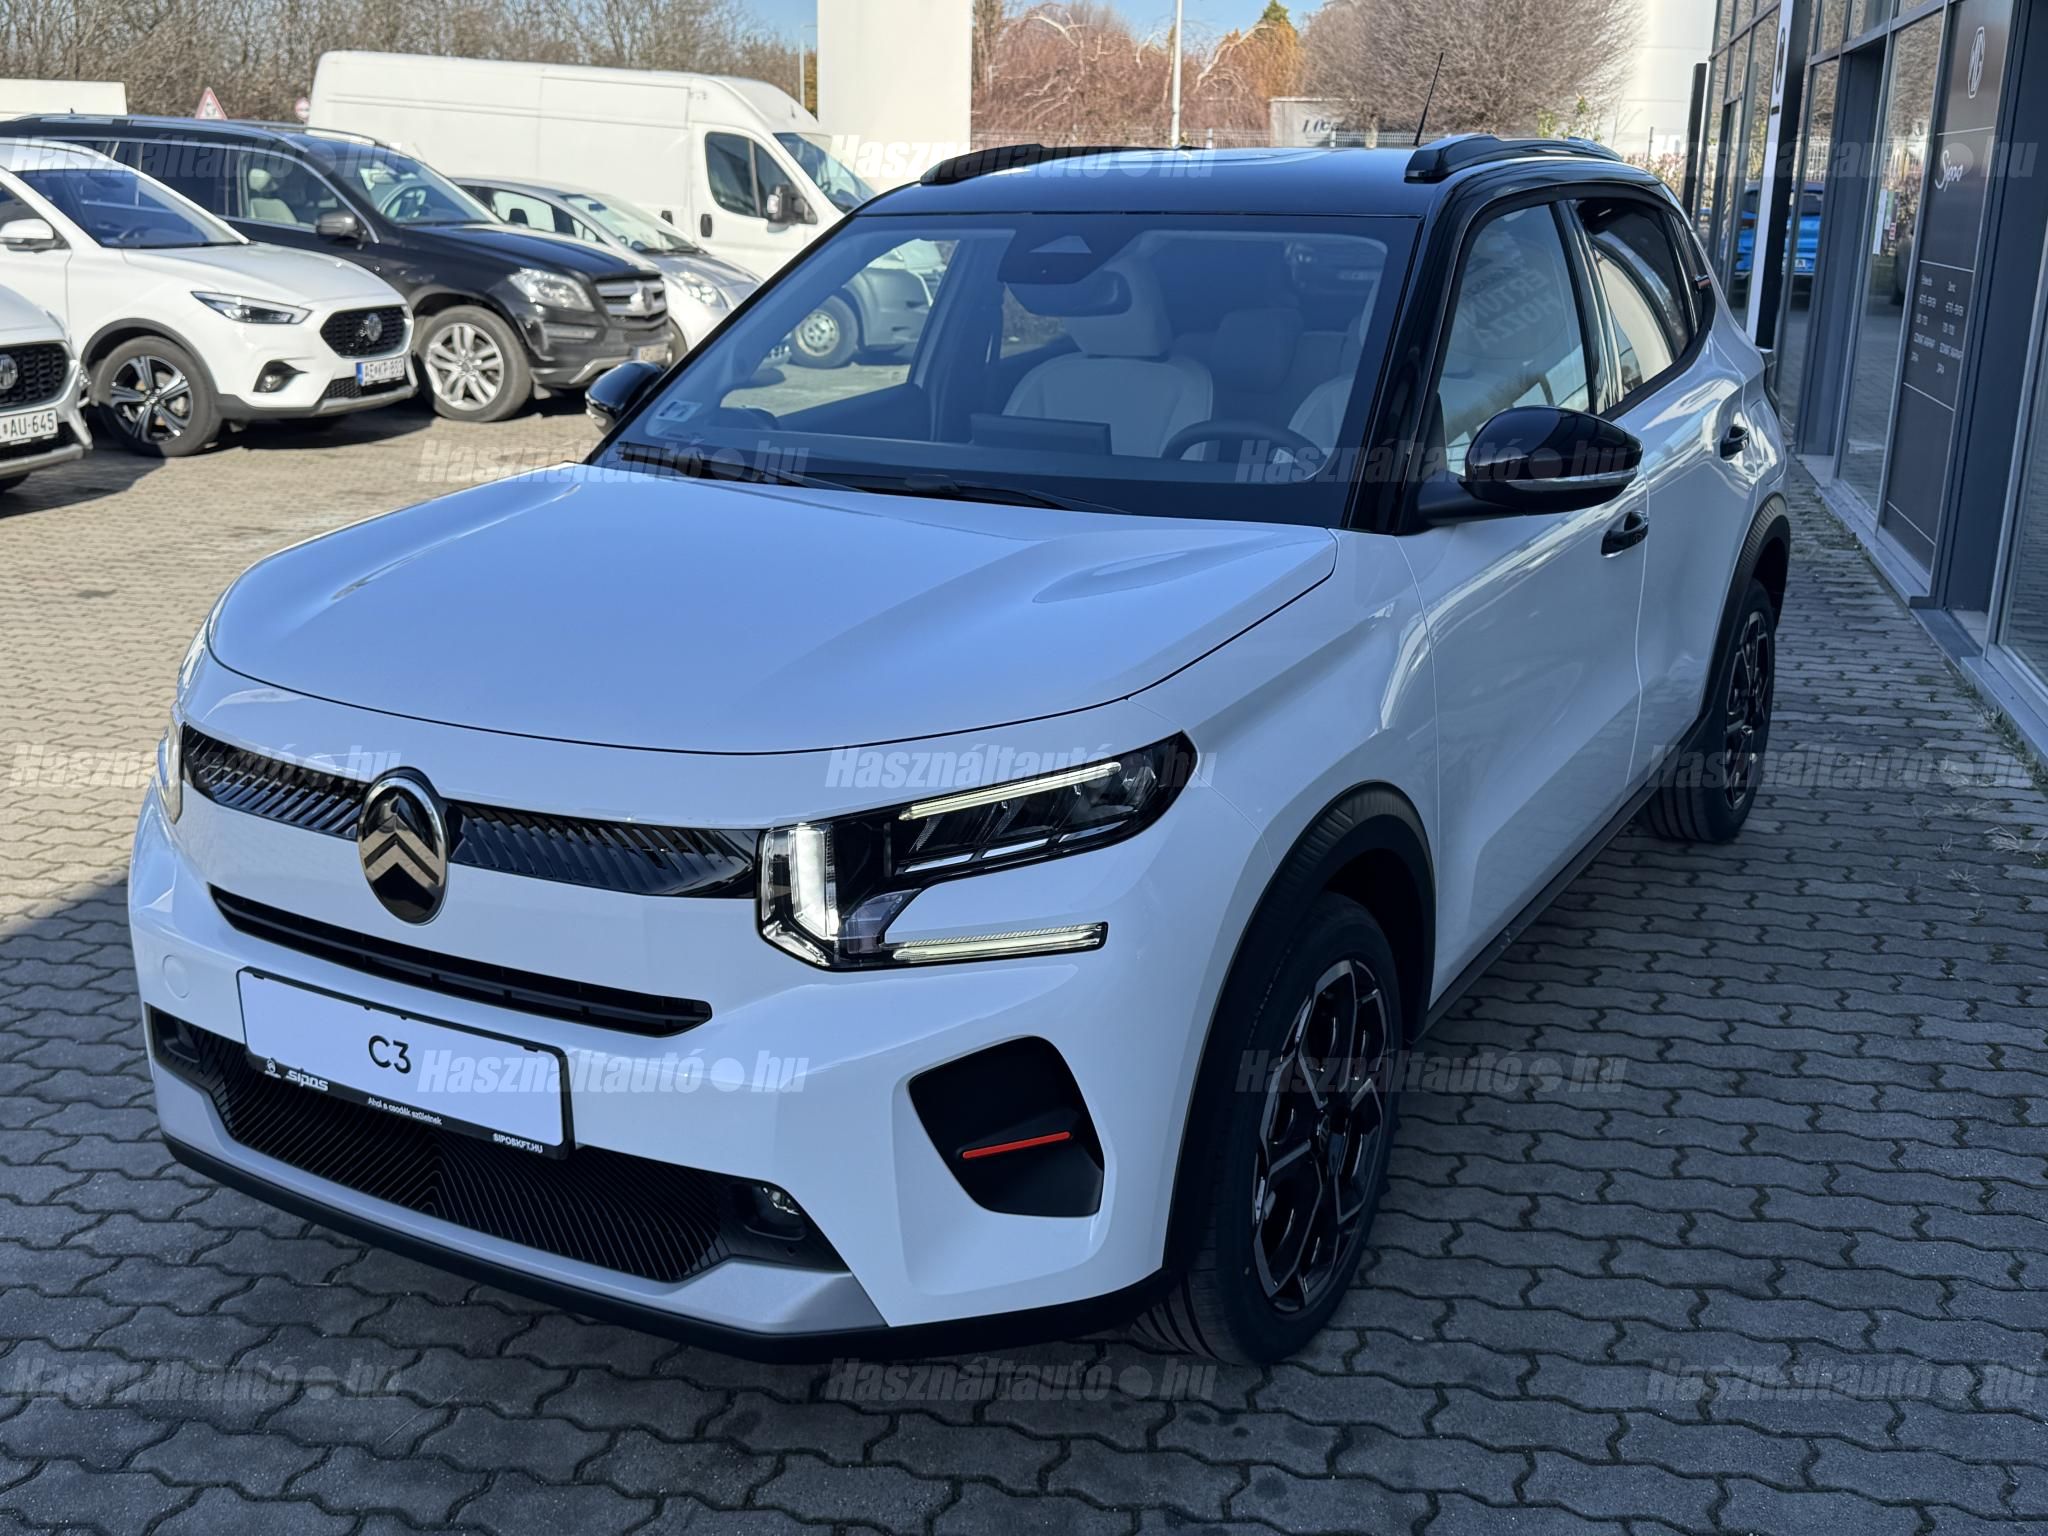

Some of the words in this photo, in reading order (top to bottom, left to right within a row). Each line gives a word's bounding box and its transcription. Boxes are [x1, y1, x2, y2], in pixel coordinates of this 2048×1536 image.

[368, 1034, 412, 1075] C3
[285, 1068, 329, 1092] sipos
[368, 1097, 382, 1109] Ahol
[492, 1132, 544, 1154] SIPOSKFT.HU
